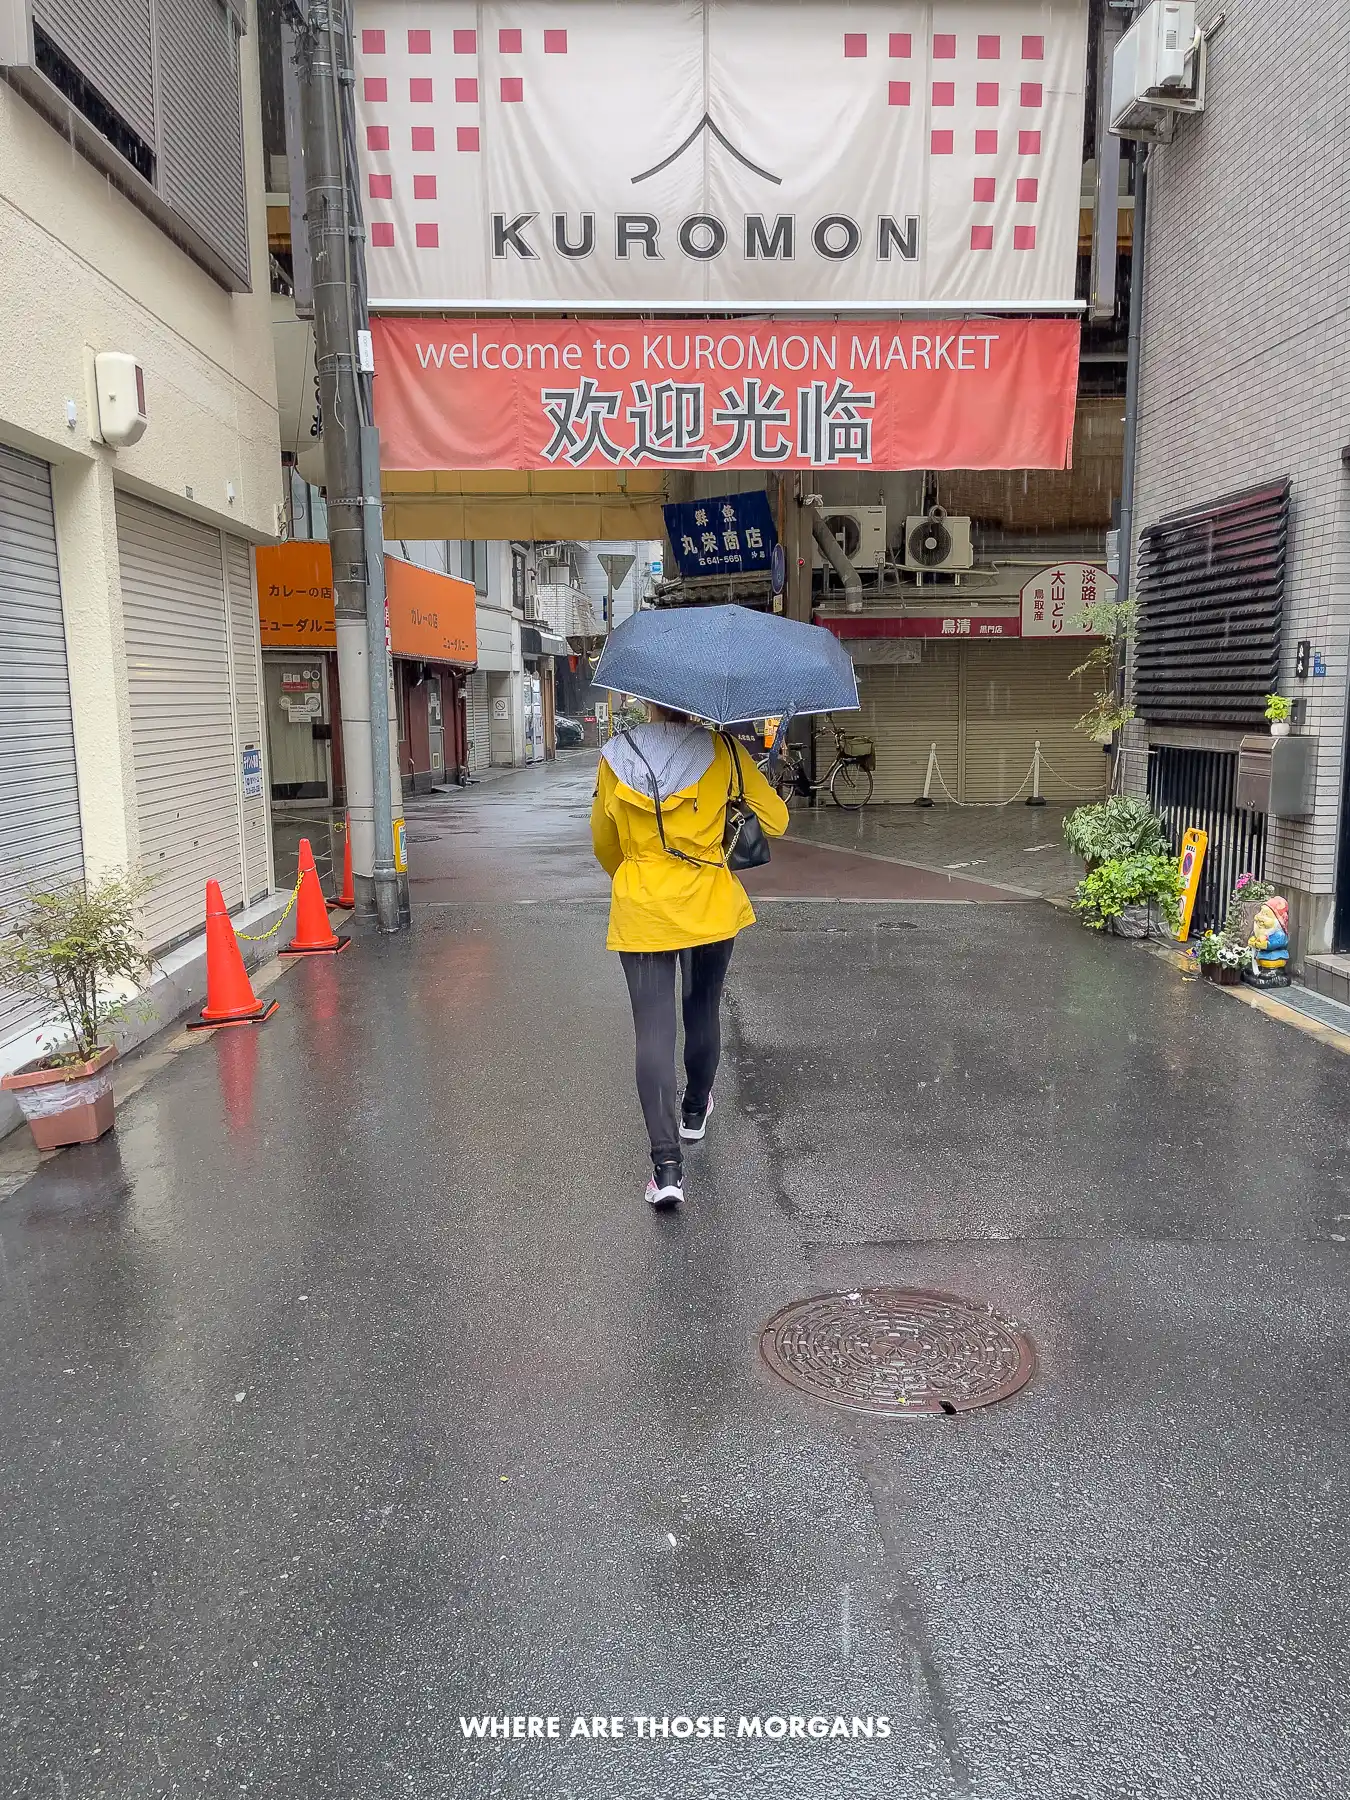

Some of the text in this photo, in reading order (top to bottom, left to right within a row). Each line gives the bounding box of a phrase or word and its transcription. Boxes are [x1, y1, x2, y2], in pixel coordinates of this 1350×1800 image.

[490, 211, 921, 262] KUROMON
[415, 333, 999, 370] welcome to KUROMON MARKET
[540, 375, 876, 468] 欢迎光临
[681, 526, 763, 556] 丸栄商店
[268, 584, 332, 599] カレーの店
[1050, 570, 1066, 633] 大山どり
[410, 608, 438, 629] カレーの店
[941, 618, 971, 634] 鳥清
